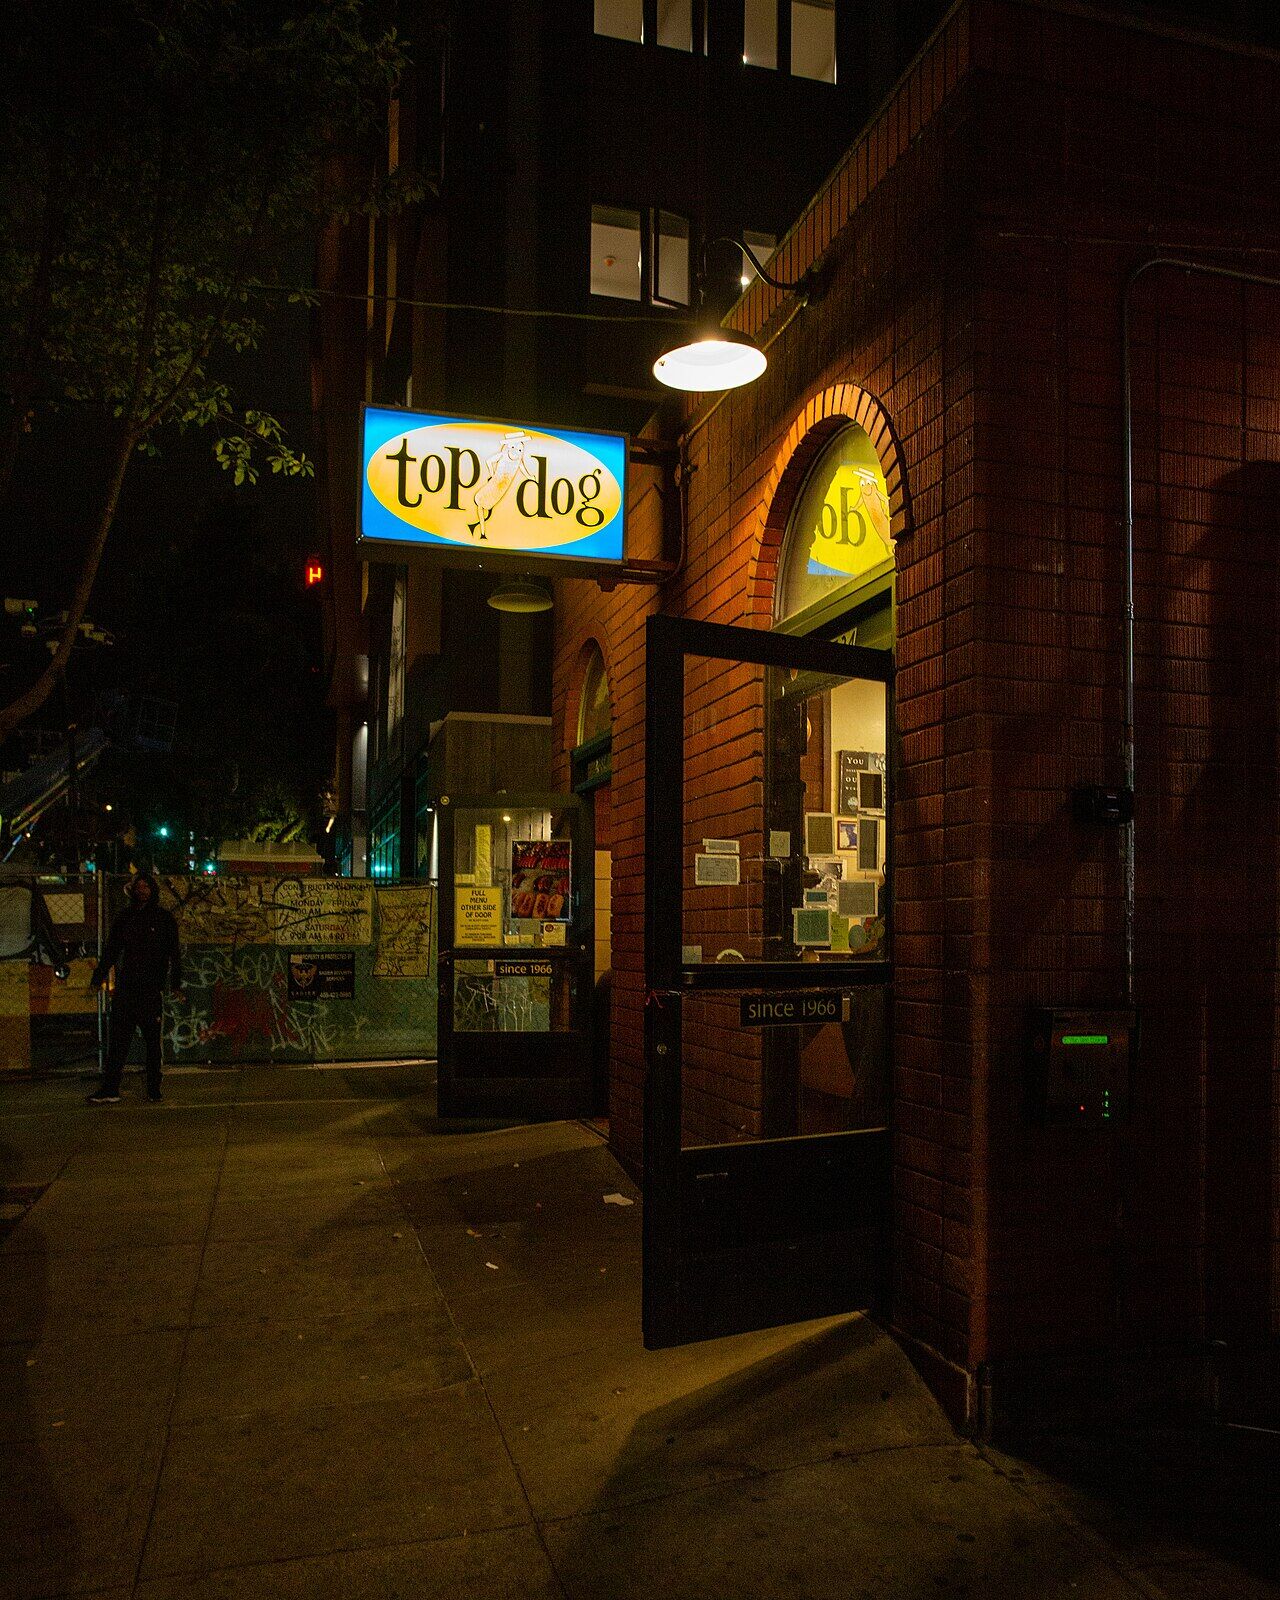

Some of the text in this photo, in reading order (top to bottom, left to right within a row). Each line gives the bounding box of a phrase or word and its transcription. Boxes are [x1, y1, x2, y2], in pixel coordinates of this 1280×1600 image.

[385, 438, 605, 527] top dog
[846, 756, 864, 765] YOU
[499, 963, 553, 974] since 1966
[748, 998, 836, 1019] since 1966
